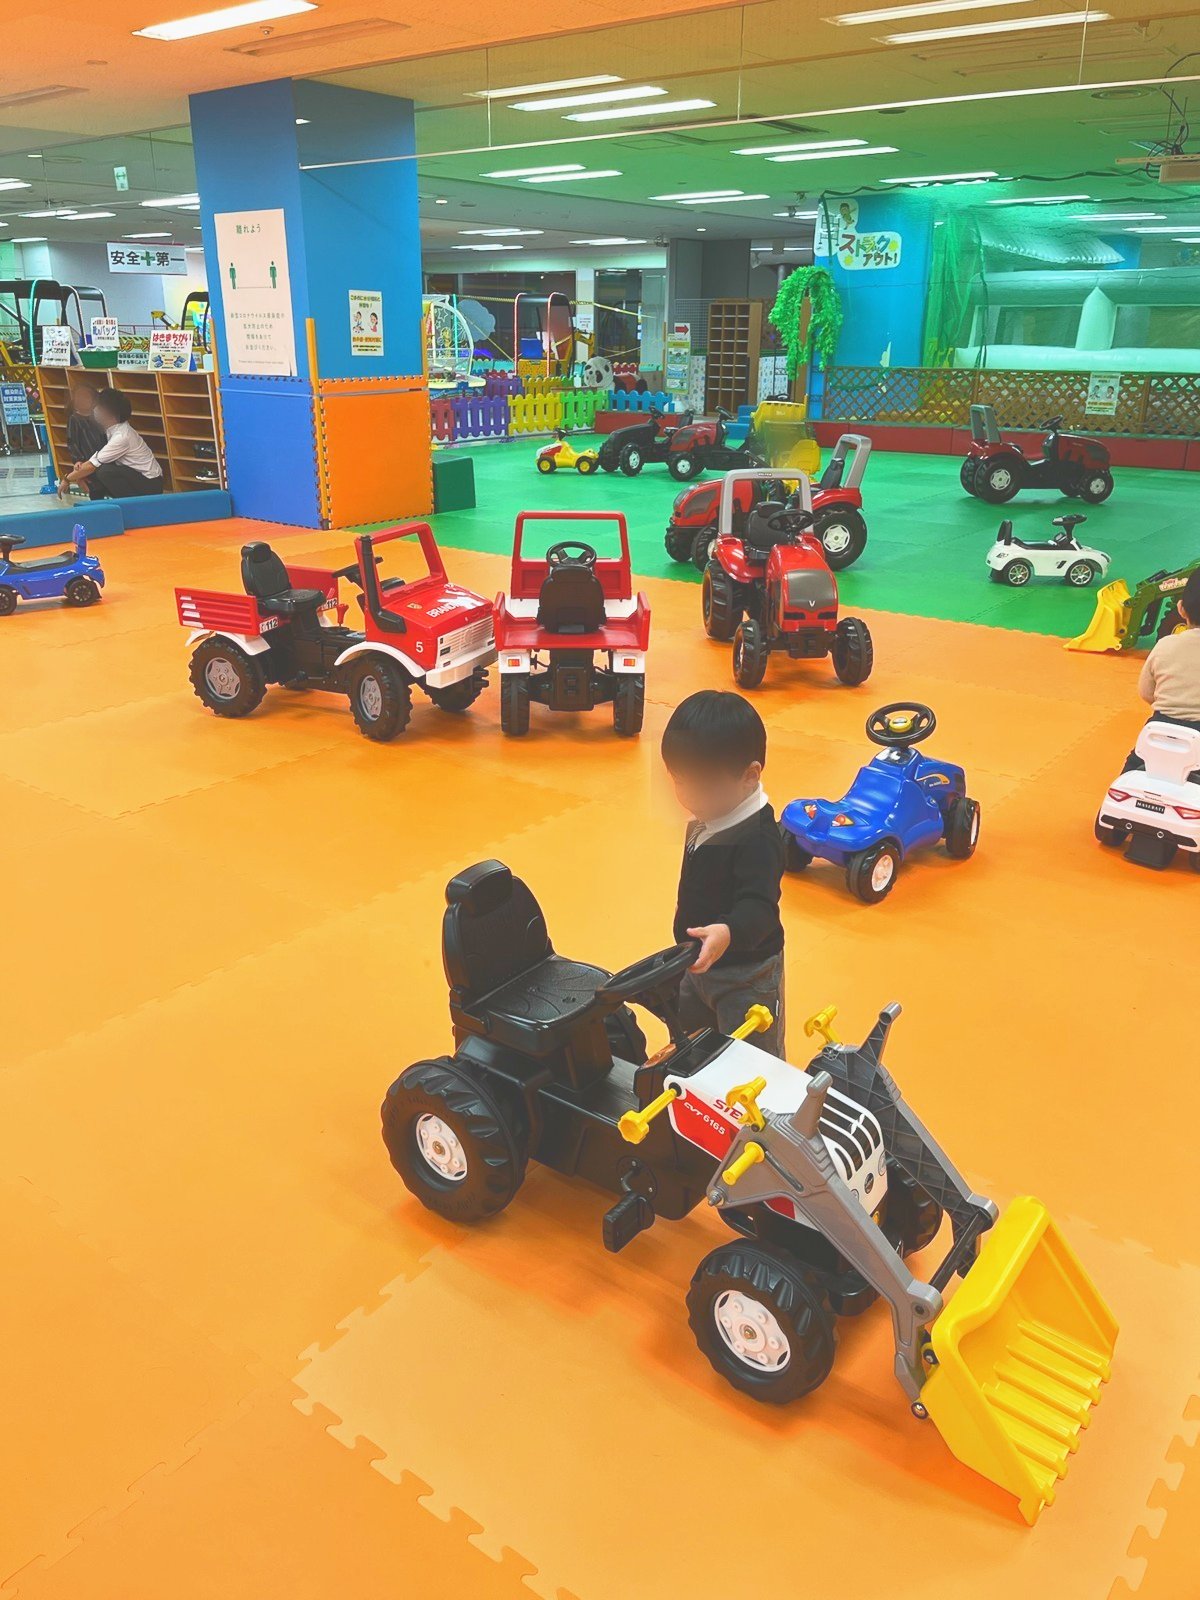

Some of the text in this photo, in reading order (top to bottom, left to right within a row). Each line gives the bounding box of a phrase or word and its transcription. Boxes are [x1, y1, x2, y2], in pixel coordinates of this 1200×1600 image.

[236, 223, 261, 234] 離れよう
[415, 641, 424, 653] 5
[1136, 801, 1165, 813] MASERATI
[703, 1114, 726, 1135] 6165
